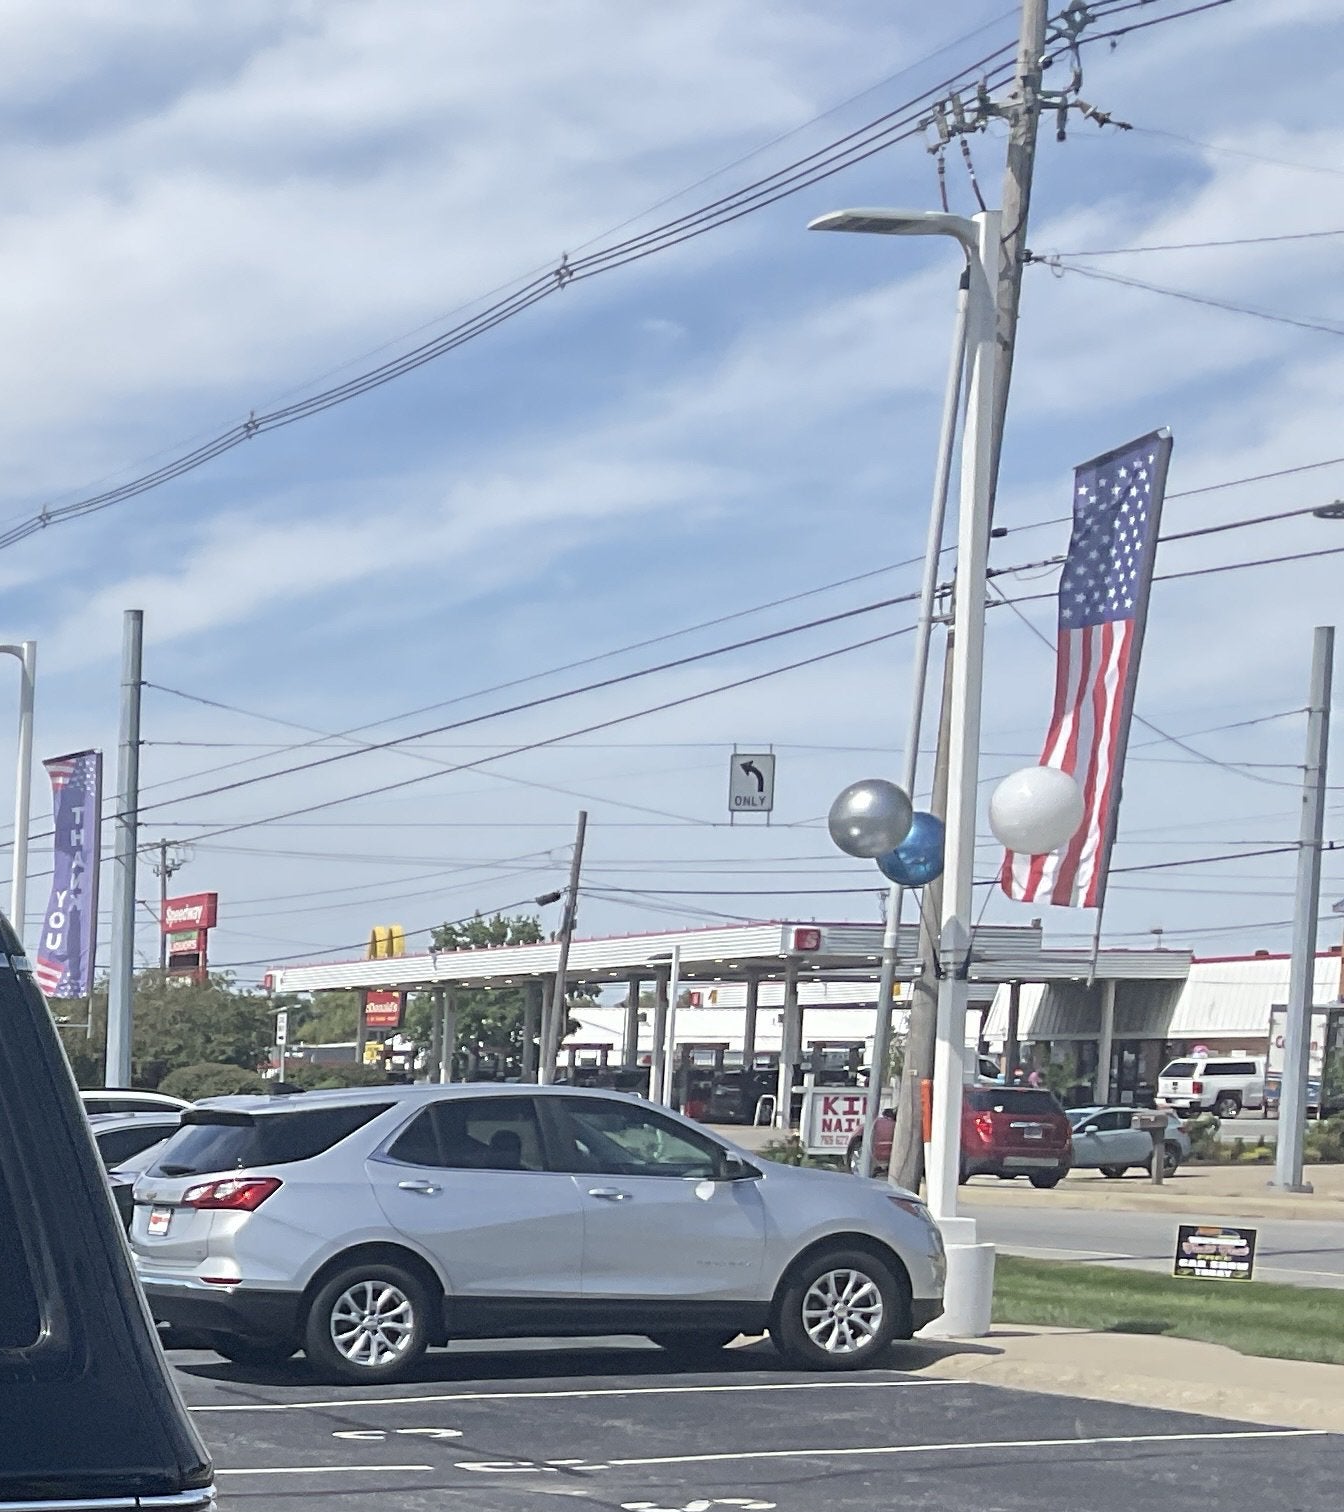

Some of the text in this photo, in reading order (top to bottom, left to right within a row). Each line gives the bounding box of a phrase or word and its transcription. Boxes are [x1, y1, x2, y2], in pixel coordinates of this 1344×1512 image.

[734, 795, 766, 807] ONLY
[45, 890, 68, 950] YOU
[165, 903, 203, 927] Speedway
[822, 1118, 861, 1133] NAI
